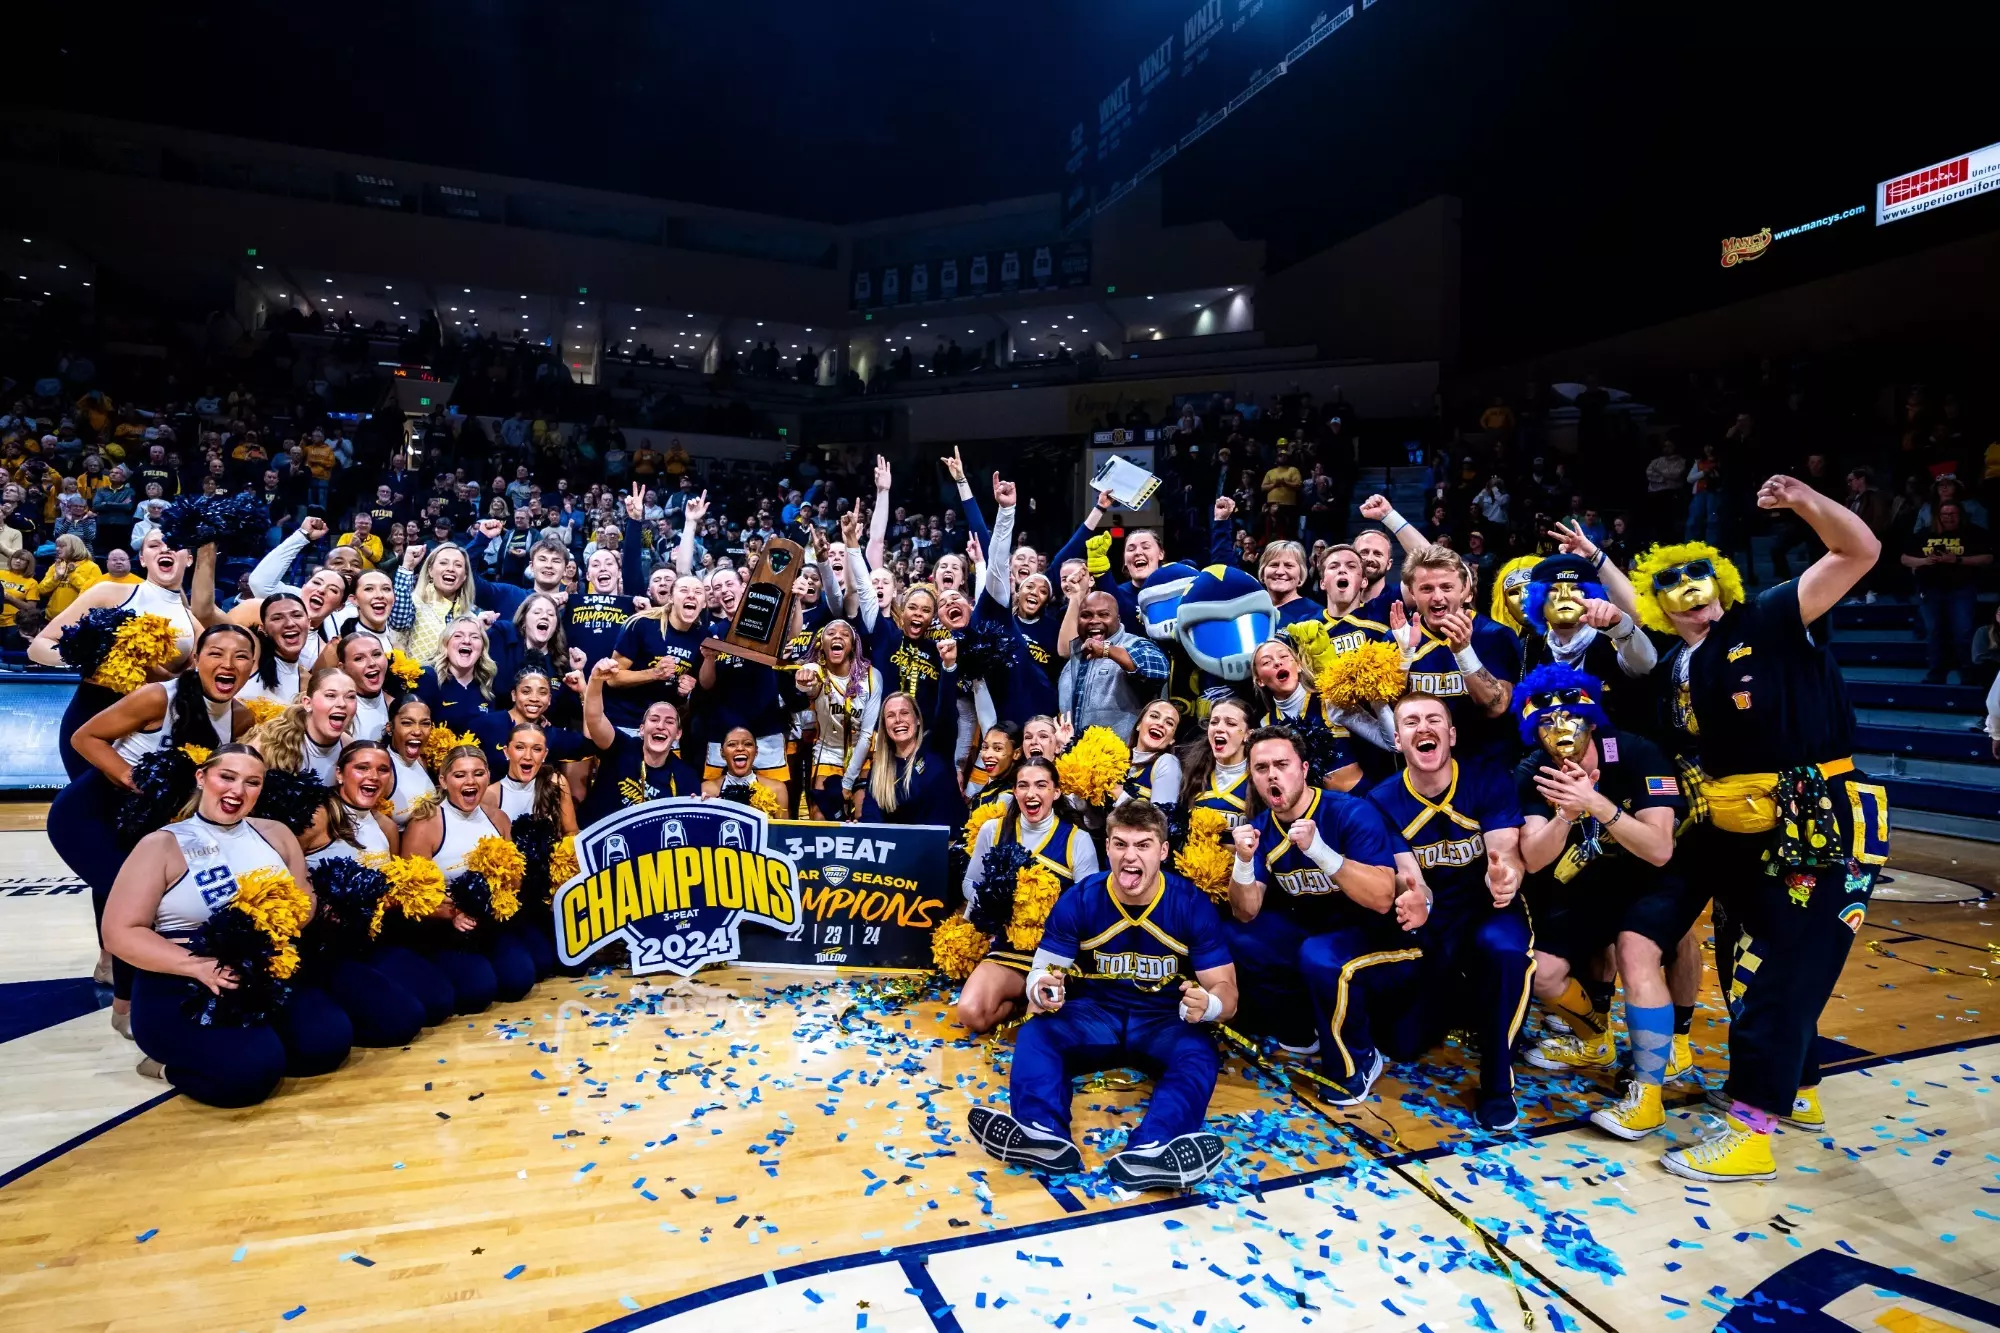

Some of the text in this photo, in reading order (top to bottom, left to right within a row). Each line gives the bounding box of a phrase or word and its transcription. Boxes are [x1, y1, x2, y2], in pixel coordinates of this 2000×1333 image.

[1139, 34, 1174, 87] WNIT
[1774, 205, 1866, 241] www.mancys.com
[1922, 546, 1965, 556] TODO
[1556, 572, 1579, 580] TOLEDO
[583, 595, 617, 605] 3-PEAT
[572, 611, 628, 625] CHAMPIONS
[666, 645, 692, 659] 3-PEAT
[1332, 631, 1367, 655] EDO
[1410, 673, 1468, 695] TOLED
[184, 845, 220, 860] Holly
[785, 836, 896, 864] 3-PEAT
[1412, 832, 1486, 869] TOLEDO
[852, 871, 918, 891] SEASON
[563, 846, 795, 957] CHAMPIONS
[801, 886, 944, 928] MPIONS
[663, 908, 700, 921] 3-PEAT
[641, 927, 730, 964] 2024
[824, 926, 842, 945] 23
[862, 926, 881, 945] 24
[815, 952, 847, 963] TOLEDO
[1094, 951, 1178, 981] TOLEDO
